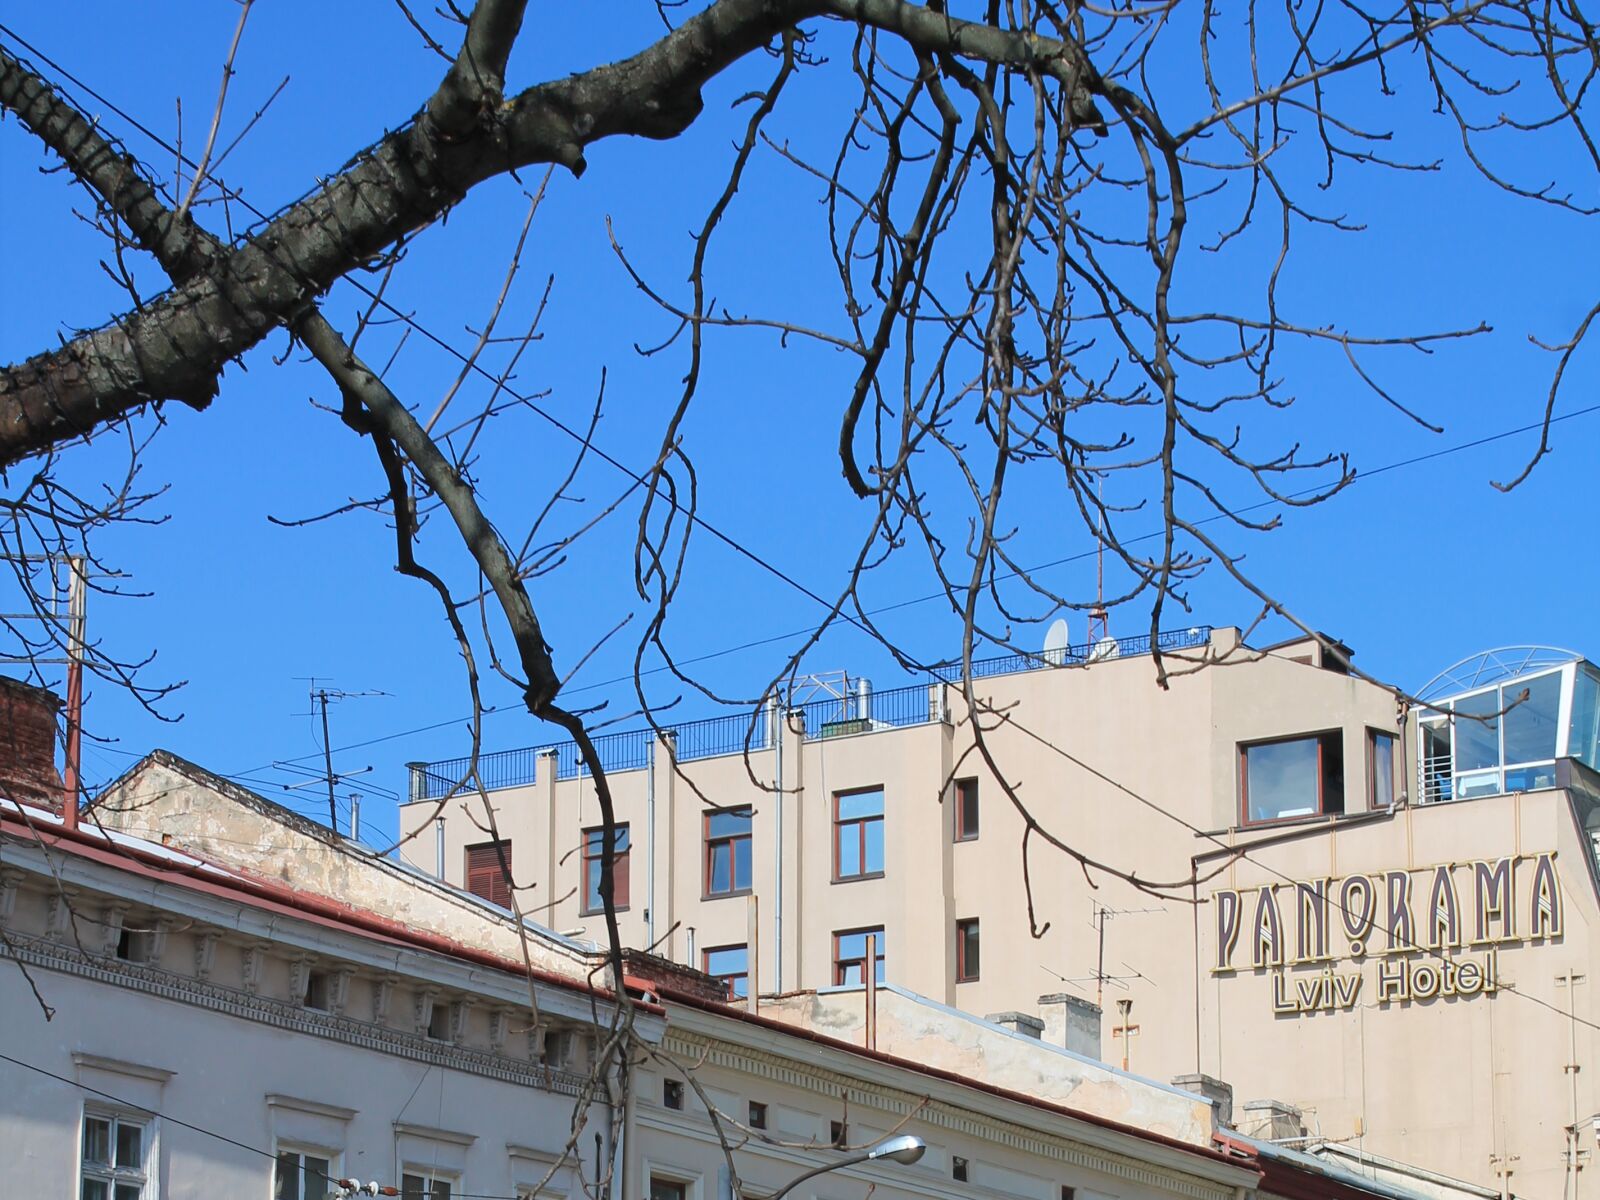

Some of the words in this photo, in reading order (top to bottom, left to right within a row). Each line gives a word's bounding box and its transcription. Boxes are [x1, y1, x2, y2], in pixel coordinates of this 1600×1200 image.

[1211, 851, 1564, 972] PANORAMA
[1271, 966, 1363, 1013] Lviv
[1377, 950, 1498, 1002] Hotel
